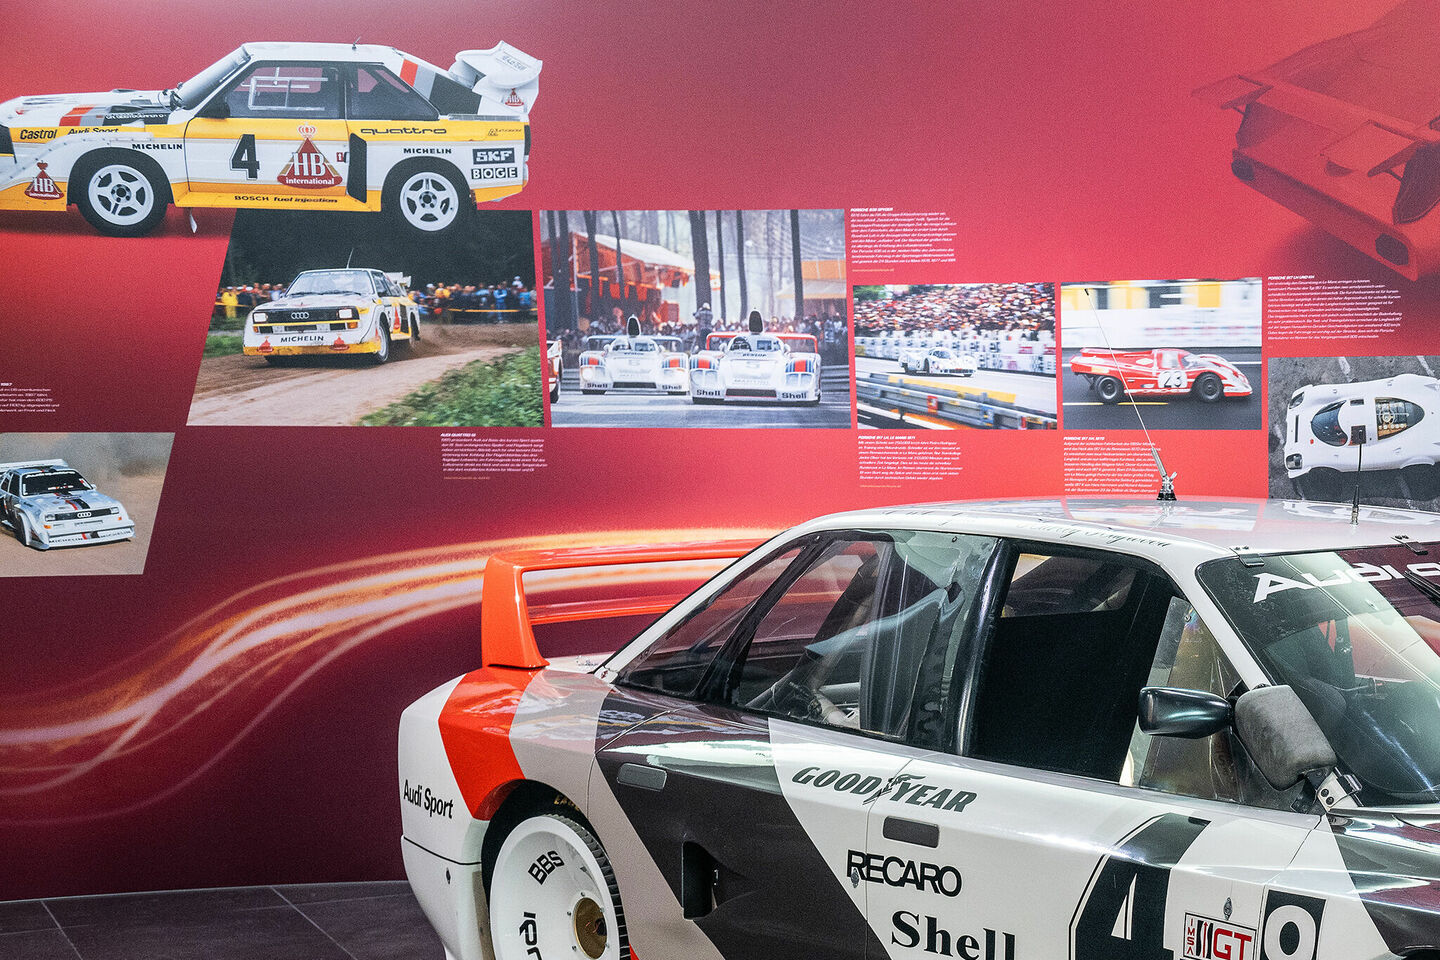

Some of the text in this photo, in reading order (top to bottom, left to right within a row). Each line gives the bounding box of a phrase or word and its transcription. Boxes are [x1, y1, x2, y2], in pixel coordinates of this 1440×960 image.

[20, 129, 57, 140] Castrol
[360, 127, 447, 136] quattro
[229, 133, 261, 181] 4
[475, 150, 513, 163] SKF
[292, 152, 326, 177] HB
[472, 168, 517, 179] BOGE
[32, 178, 54, 193] HB
[285, 177, 335, 186] international
[280, 335, 324, 343] MICHELIN
[696, 389, 721, 397] Shell
[782, 391, 807, 400] Shell
[1253, 564, 1401, 604] Audi
[403, 779, 454, 820] Audi Sport
[527, 850, 566, 886] BBS
[847, 849, 963, 898] RECARO
